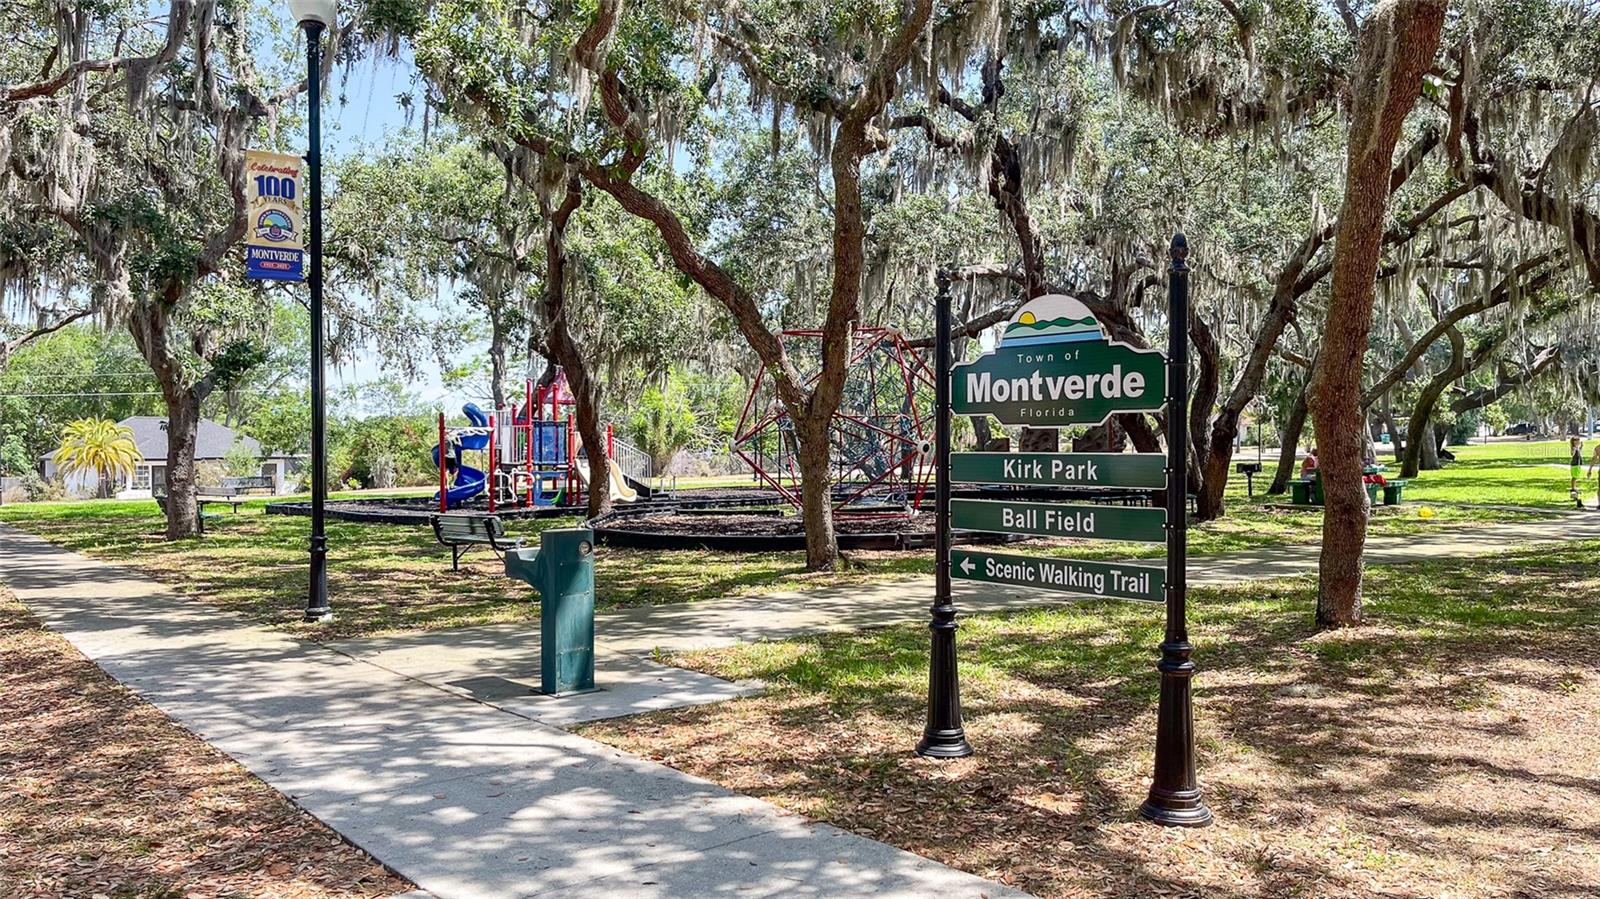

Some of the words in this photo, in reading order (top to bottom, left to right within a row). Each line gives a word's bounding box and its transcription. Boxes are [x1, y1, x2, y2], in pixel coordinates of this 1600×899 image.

[251, 162, 299, 178] Celebrating
[254, 175, 295, 200] 100
[264, 196, 287, 206] YEARS
[251, 248, 300, 262] MONTVERDE
[1017, 353, 1054, 364] Town
[1064, 349, 1080, 361] of
[966, 364, 1145, 403] Montverde
[1020, 407, 1075, 418] Florida
[1003, 458, 1043, 479] Kirk
[1051, 459, 1098, 481] Park
[1002, 507, 1037, 529] Ball
[1045, 510, 1095, 533] Field
[985, 557, 1035, 582] Scenic
[1038, 562, 1105, 594] Walking
[1110, 569, 1150, 594] Trail
